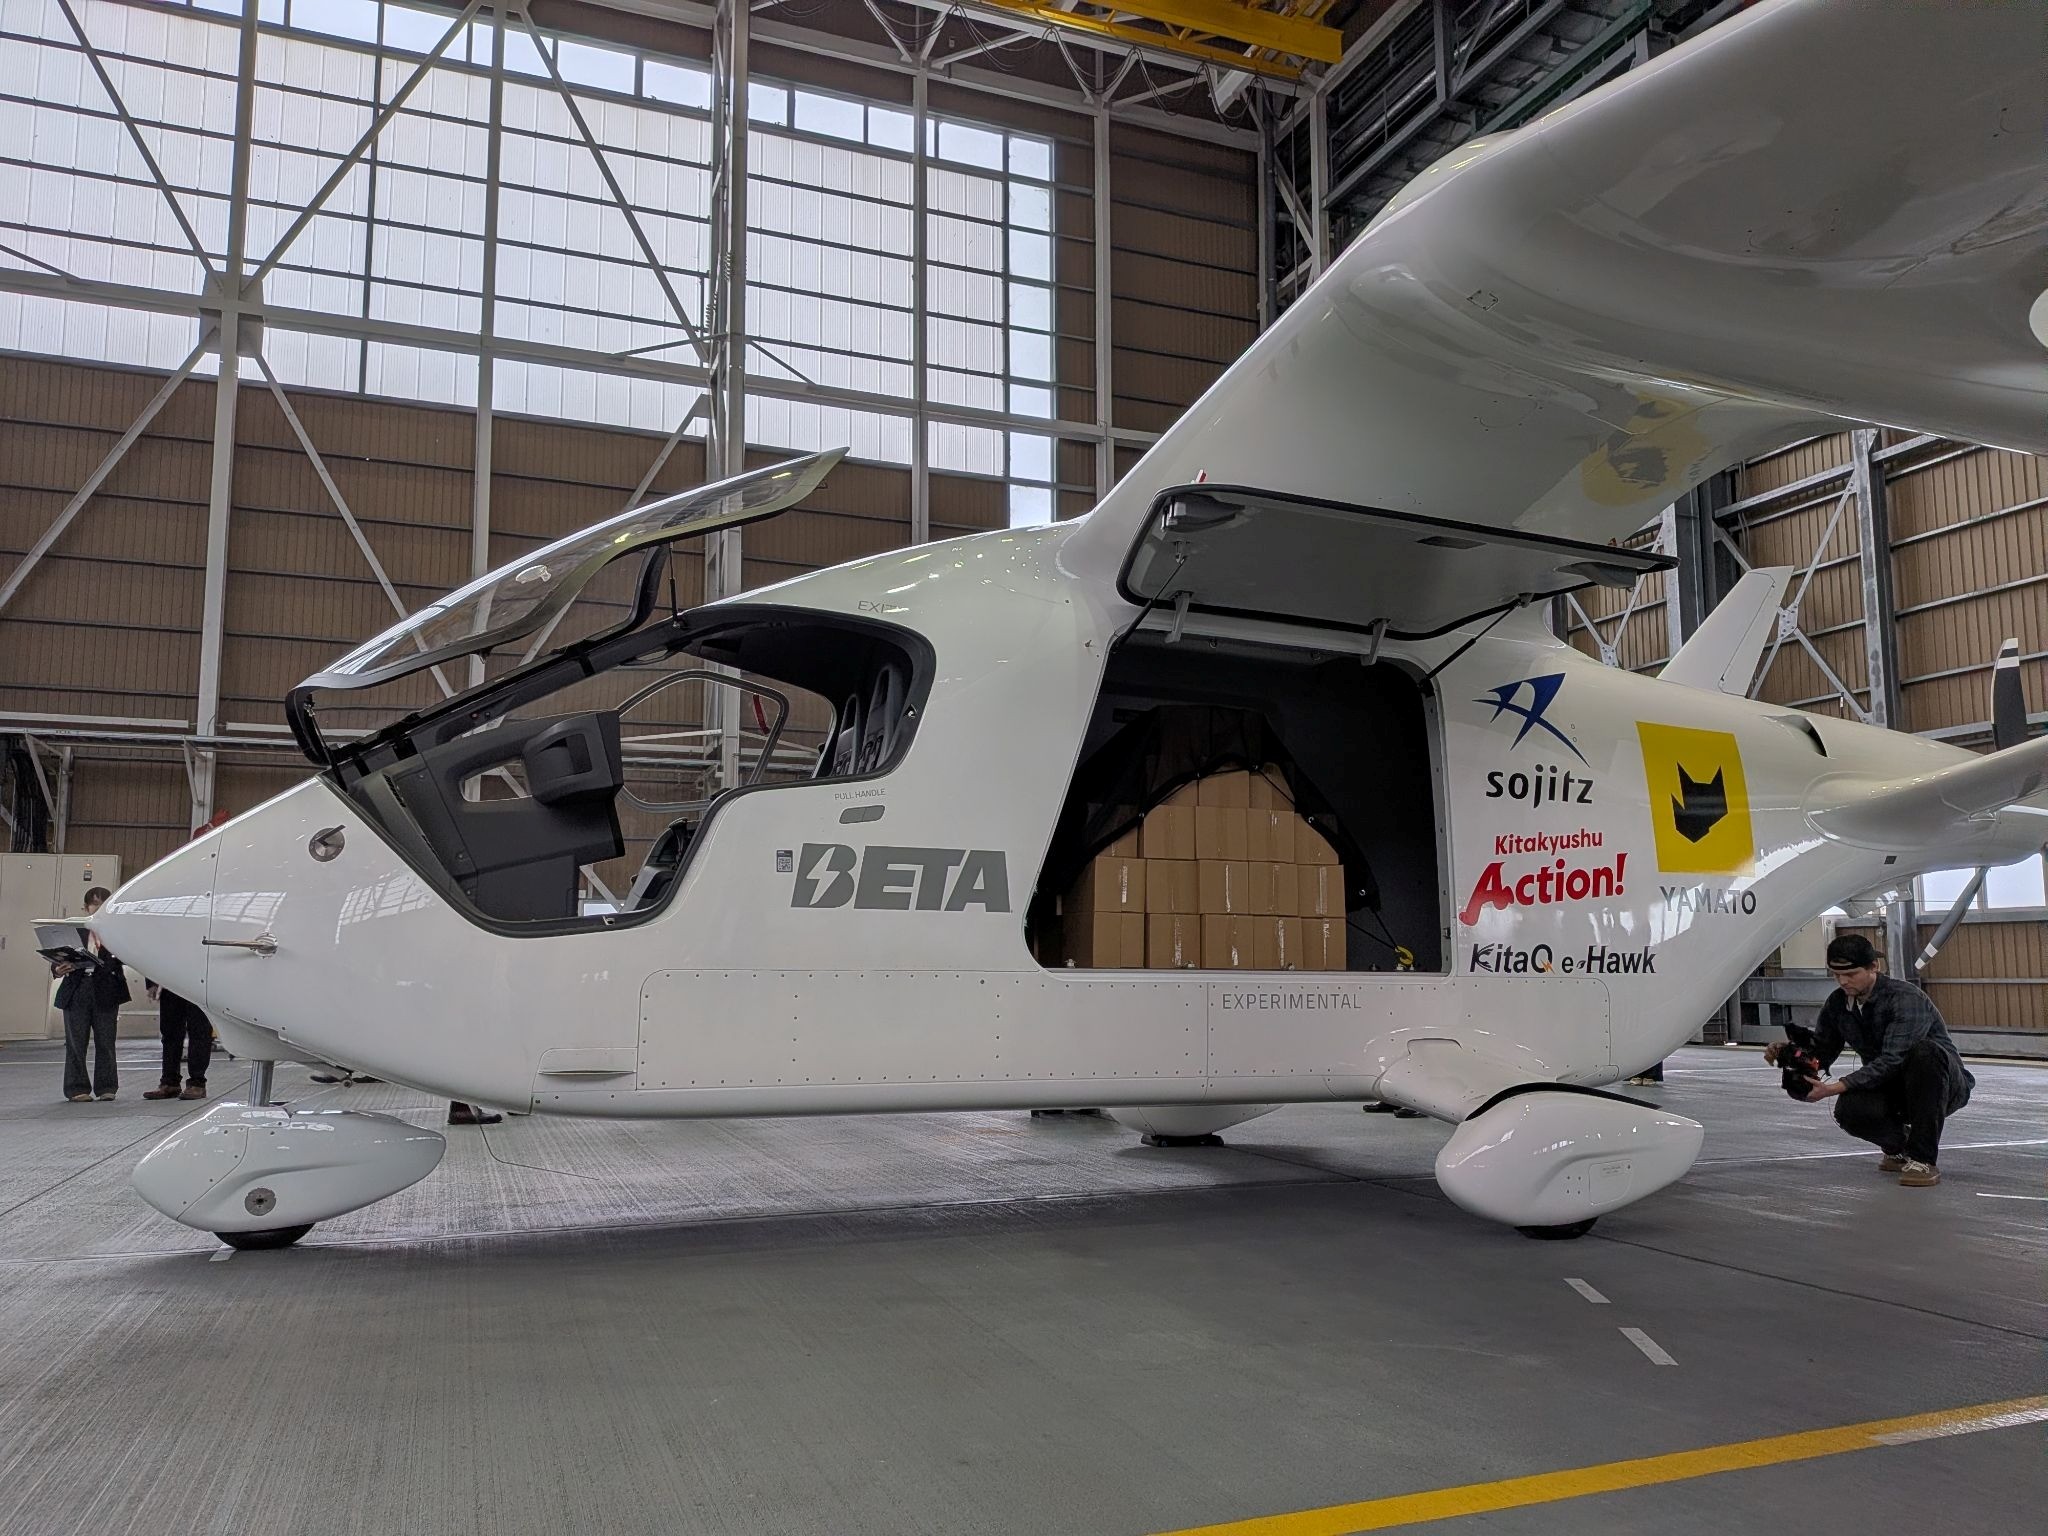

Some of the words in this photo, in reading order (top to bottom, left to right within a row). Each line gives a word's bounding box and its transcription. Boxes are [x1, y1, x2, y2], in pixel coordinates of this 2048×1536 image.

[834, 791, 855, 800] PULL
[855, 788, 886, 798] HANDLE
[1486, 764, 1593, 808] sojitz
[1495, 828, 1603, 856] Kitakyushu
[791, 843, 1011, 913] BETA
[1458, 852, 1629, 927] Action!
[1659, 886, 1757, 915] YAMATO
[1469, 943, 1555, 975] KitaQ
[1222, 993, 1362, 1010] EXPERIMENTAL
